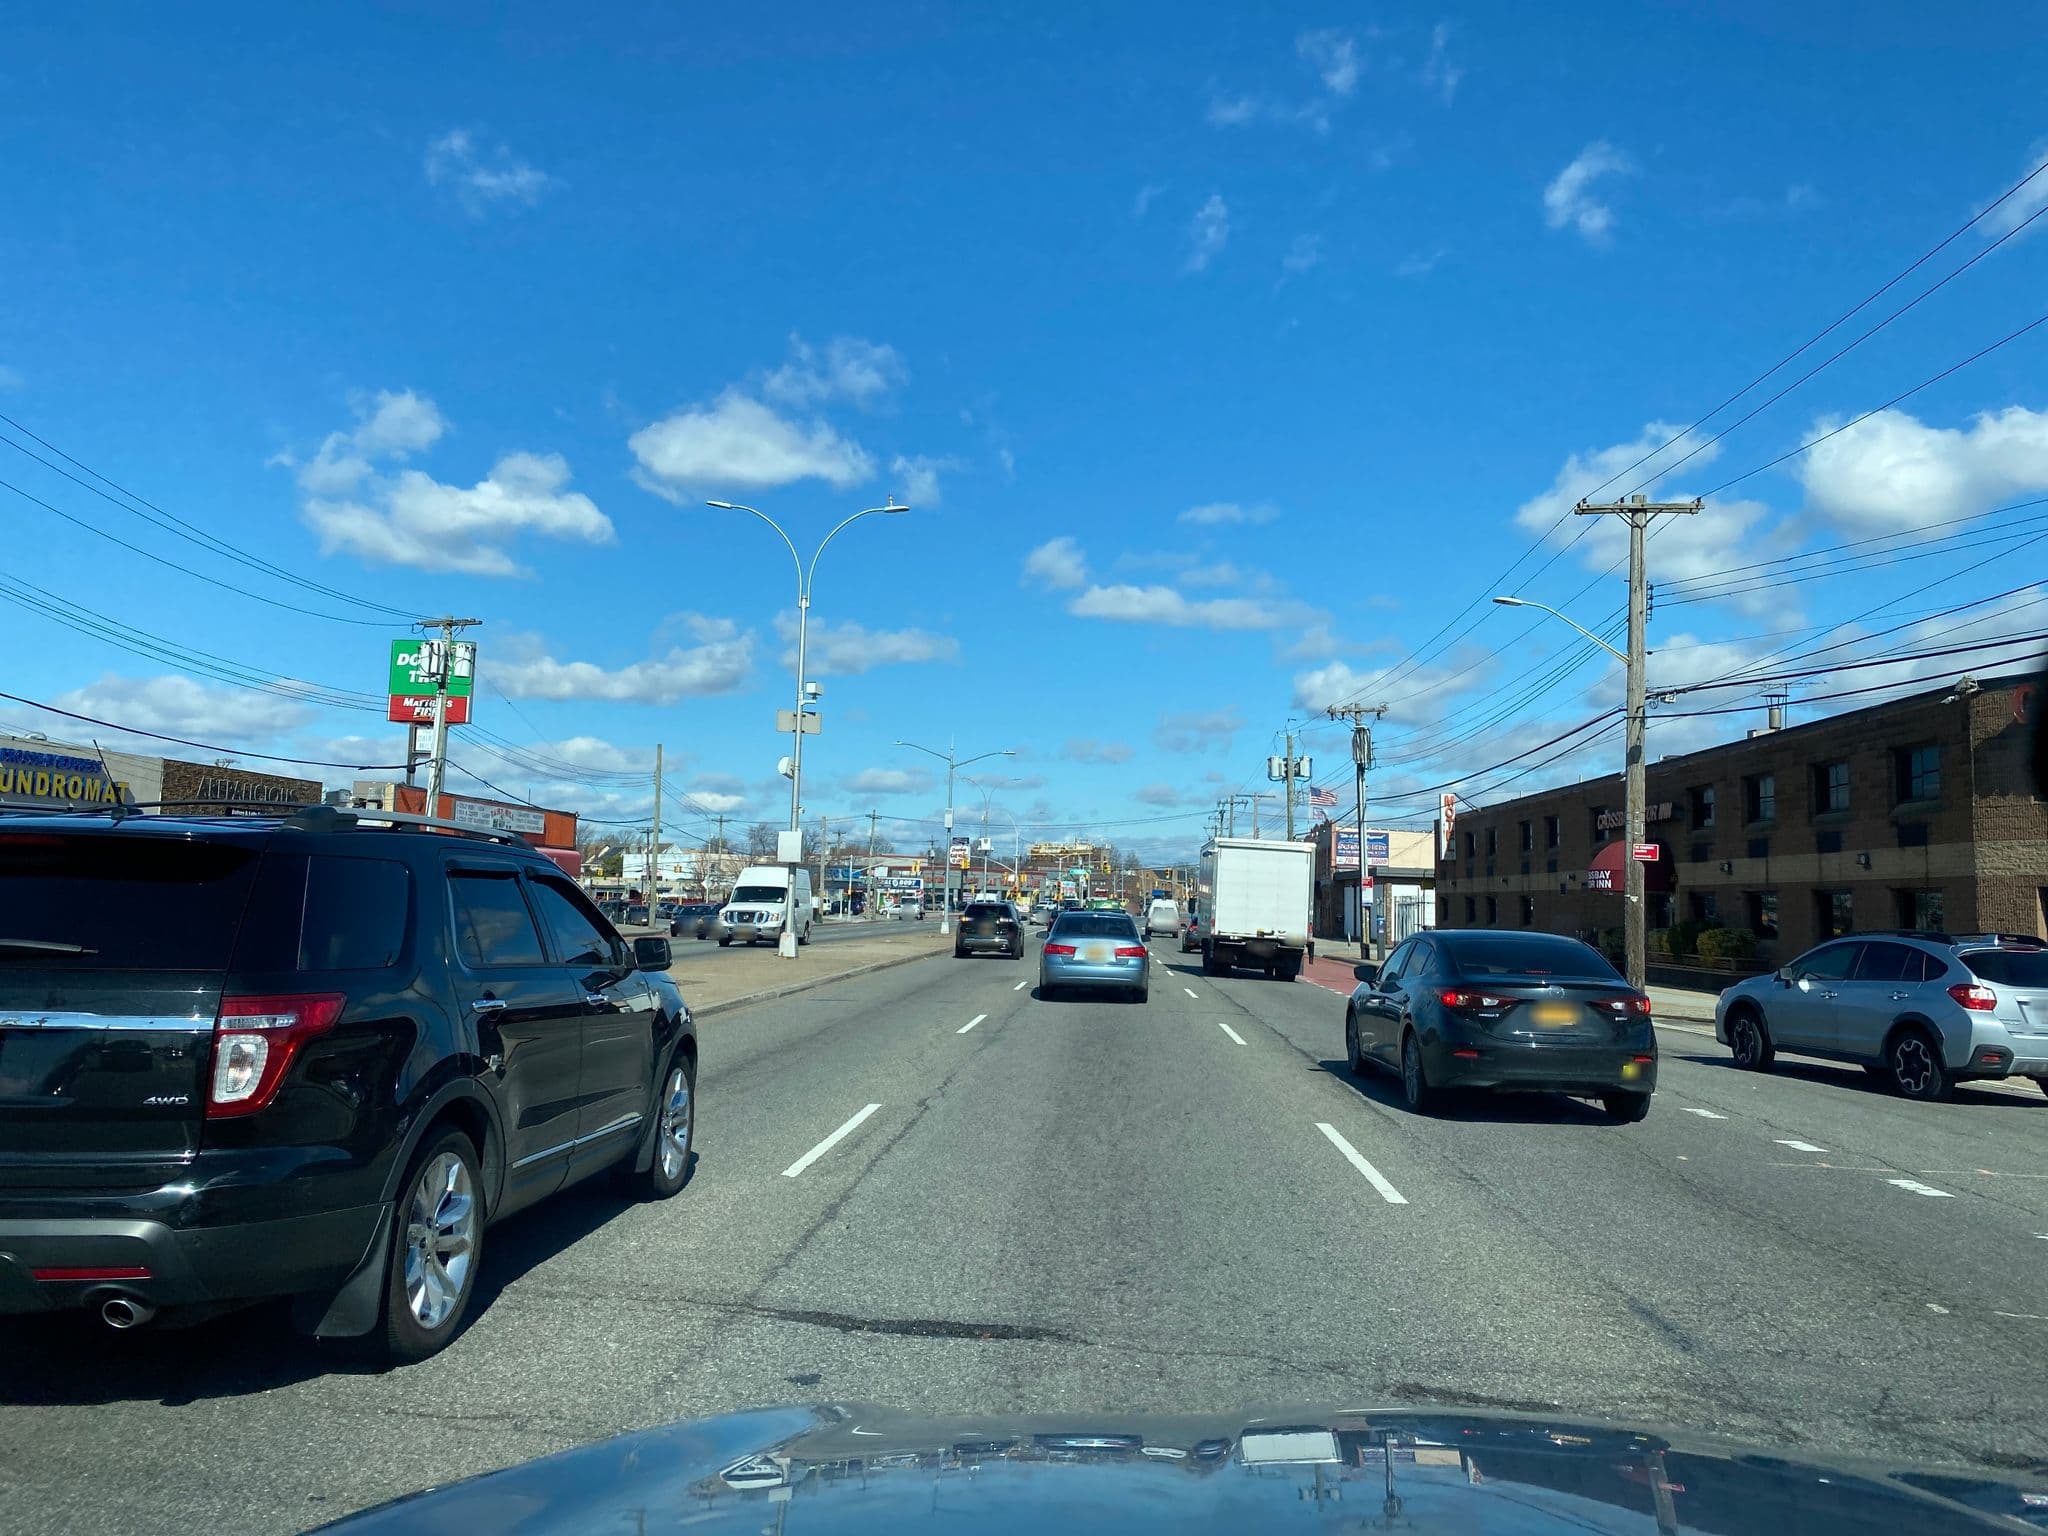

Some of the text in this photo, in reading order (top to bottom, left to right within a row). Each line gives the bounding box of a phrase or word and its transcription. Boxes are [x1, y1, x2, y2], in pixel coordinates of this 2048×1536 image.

[0, 768, 129, 804] UNDROMAT
[1597, 811, 1624, 830] CROSSB
[1596, 879, 1612, 889] INN
[142, 1096, 189, 1105] 4WD
